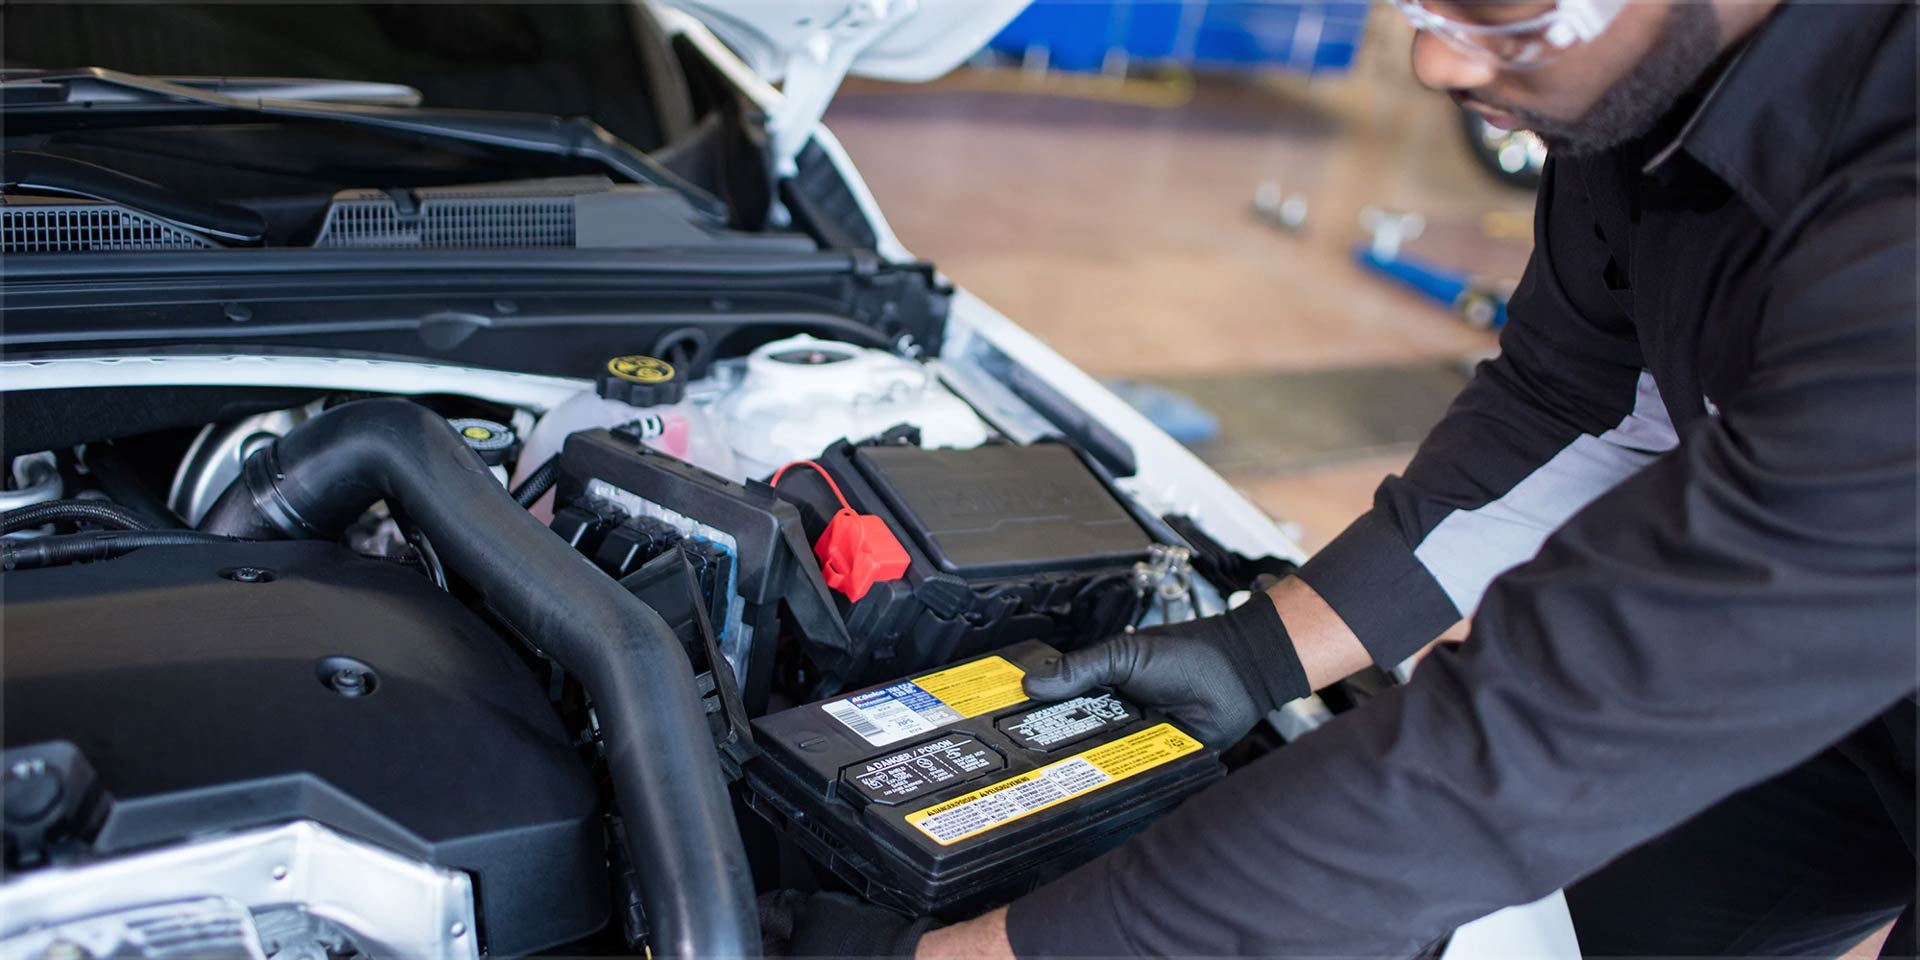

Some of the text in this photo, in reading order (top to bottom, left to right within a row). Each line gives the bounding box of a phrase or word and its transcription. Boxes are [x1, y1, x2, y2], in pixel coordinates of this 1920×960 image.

[852, 690, 885, 702] ACDelco
[873, 753, 912, 769] DANGER
[918, 740, 953, 754] POISON
